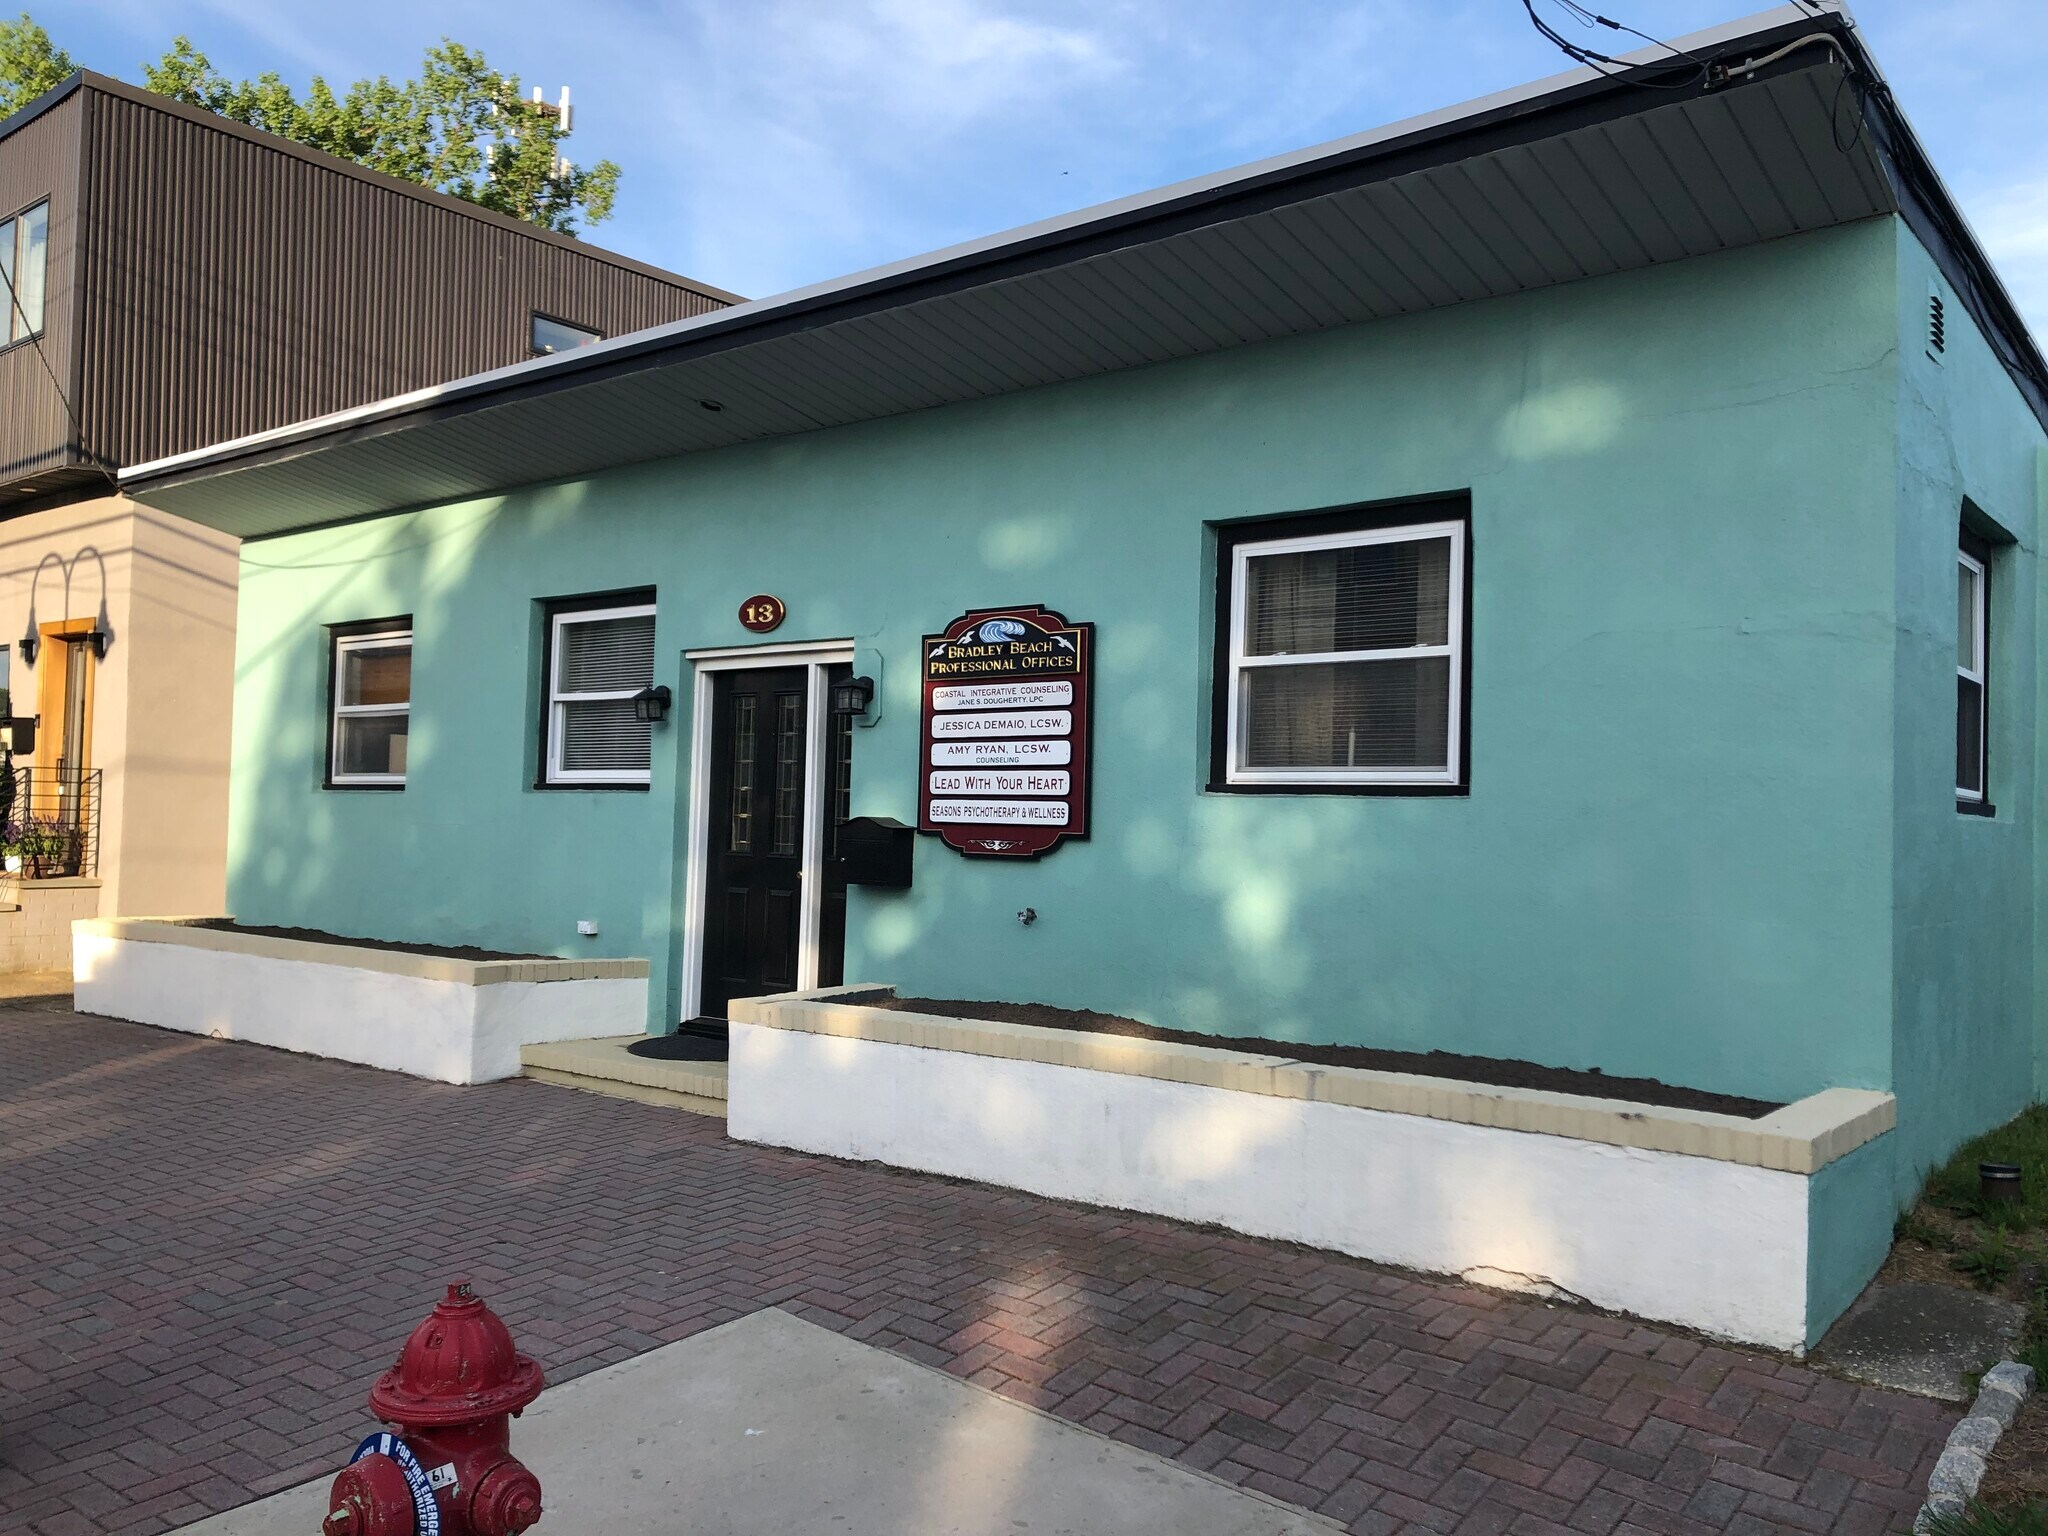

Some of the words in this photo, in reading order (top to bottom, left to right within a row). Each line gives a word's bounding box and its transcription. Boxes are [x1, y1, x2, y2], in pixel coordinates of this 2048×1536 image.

[746, 604, 774, 623] 13
[948, 644, 1003, 659] BRADLEY
[1010, 641, 1052, 655] BEACH
[930, 659, 1017, 674] PROFESSIONAL
[1022, 656, 1073, 669] OFFICES
[935, 690, 966, 699] COASTAL
[970, 687, 1016, 697] INTEGRATIVE
[1020, 684, 1070, 694] COUNSELING
[957, 698, 975, 706] JANE
[976, 697, 982, 705] S.
[1029, 695, 1044, 703] LPC
[939, 721, 981, 731] JESSICA
[1030, 718, 1064, 729] LCSW.
[947, 745, 971, 755] AMY
[975, 744, 1009, 754] RYAN,
[1014, 744, 1051, 754] LCSW.
[934, 776, 960, 790] LEAD
[964, 776, 991, 790] WITH
[996, 776, 1023, 790] YOUR
[1027, 776, 1064, 790] HEART
[931, 805, 961, 817] SEASONS
[963, 806, 1020, 818] PSYCHOTHERAPY
[1021, 807, 1027, 818] &
[1028, 807, 1066, 819] WELLNESS
[395, 1440, 411, 1462] FOR
[408, 1457, 426, 1484] FIRE
